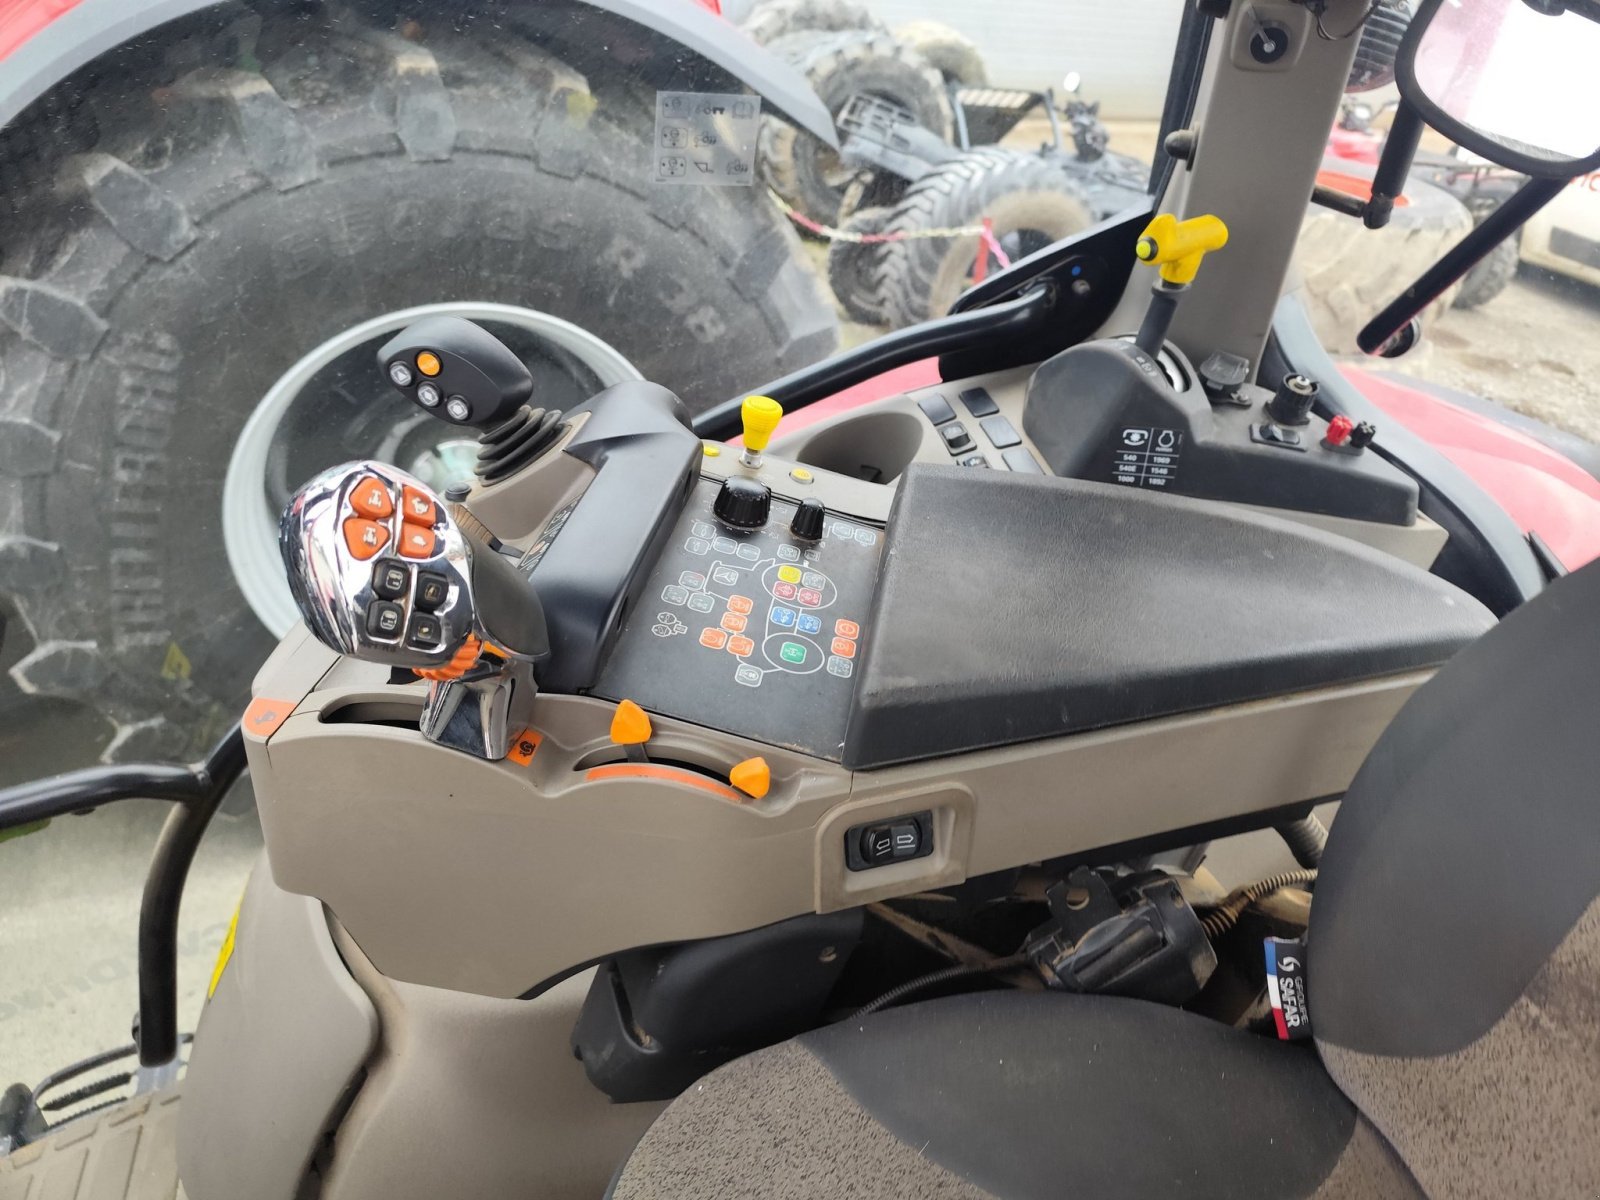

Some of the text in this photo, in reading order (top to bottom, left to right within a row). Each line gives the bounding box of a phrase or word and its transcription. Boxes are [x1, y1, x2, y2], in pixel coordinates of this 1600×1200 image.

[1123, 454, 1137, 462] 540
[1119, 465, 1137, 473] 540E
[1118, 475, 1135, 483] 1000
[1279, 977, 1301, 1028] SAFAR
[1294, 976, 1309, 1026] GROUPE
